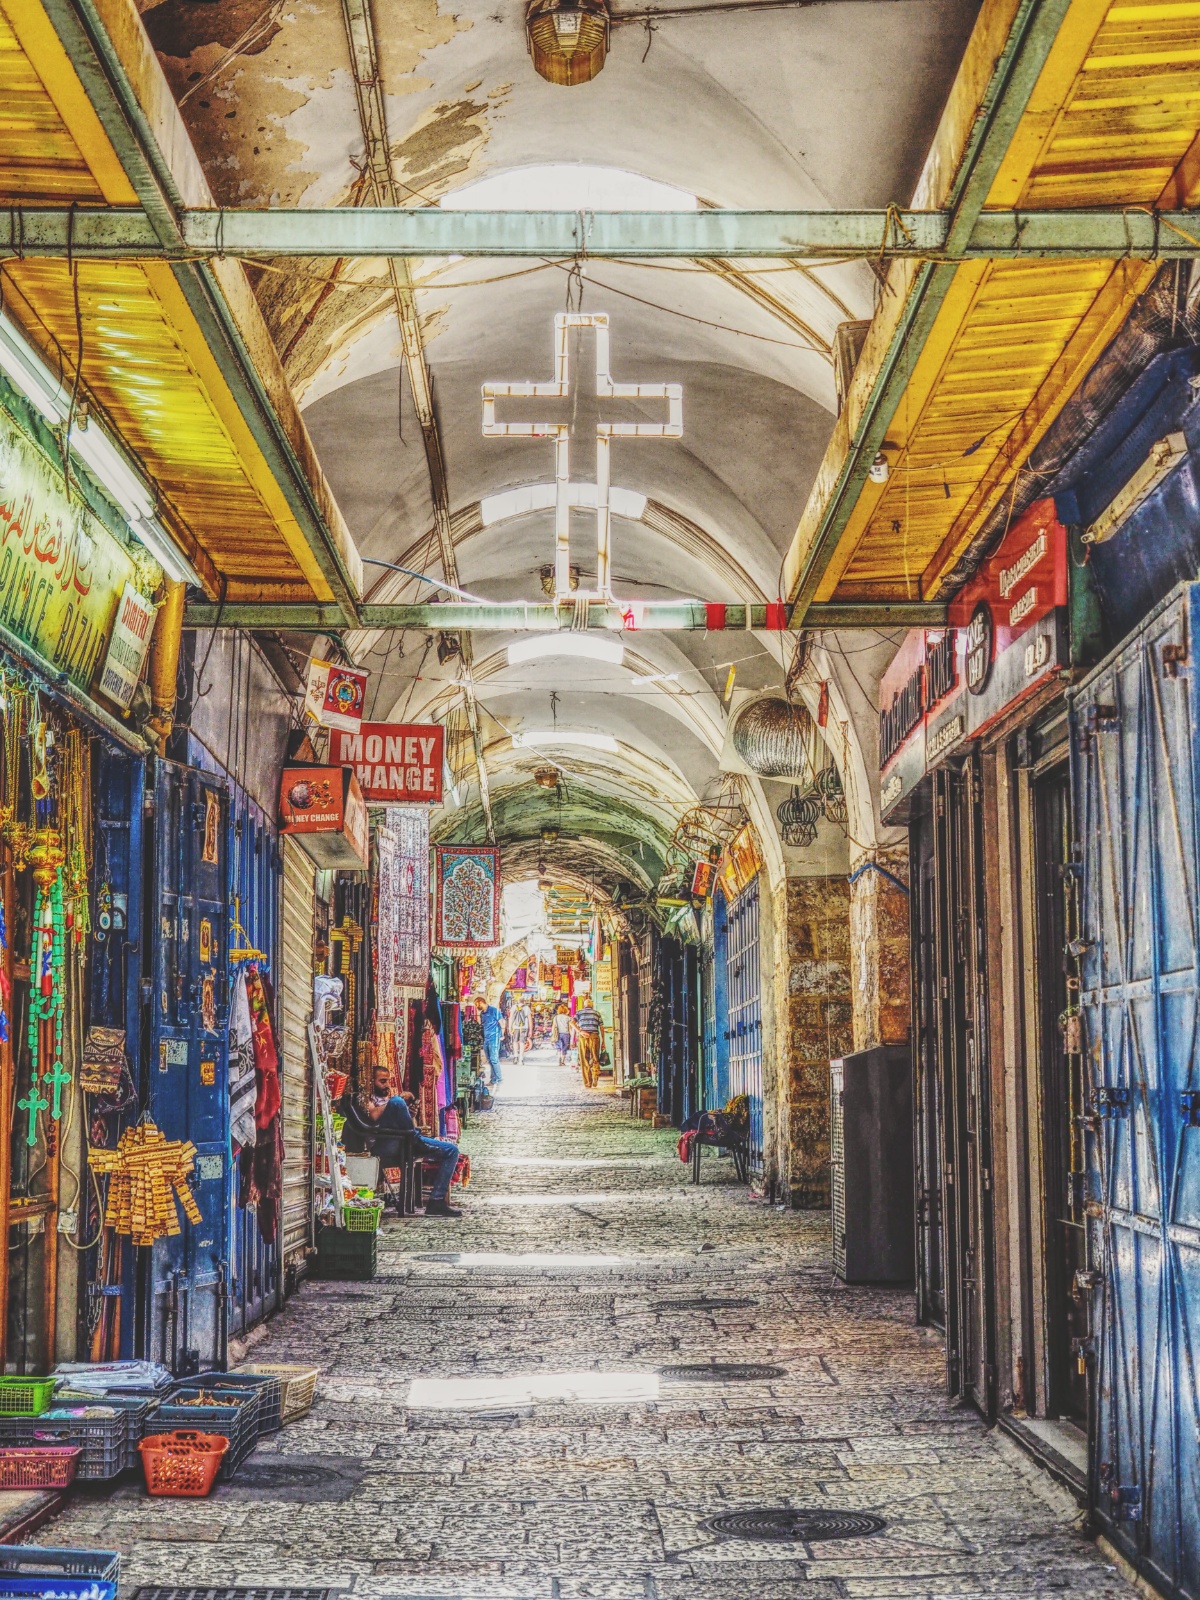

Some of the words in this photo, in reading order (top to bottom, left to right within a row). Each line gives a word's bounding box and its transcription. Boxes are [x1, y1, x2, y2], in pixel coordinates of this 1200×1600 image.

[121, 595, 151, 641] DIMITRI
[53, 602, 106, 689] BAZAAR
[339, 734, 436, 765] MONEY
[340, 764, 435, 792] HANGE
[310, 812, 339, 822] CHANGE
